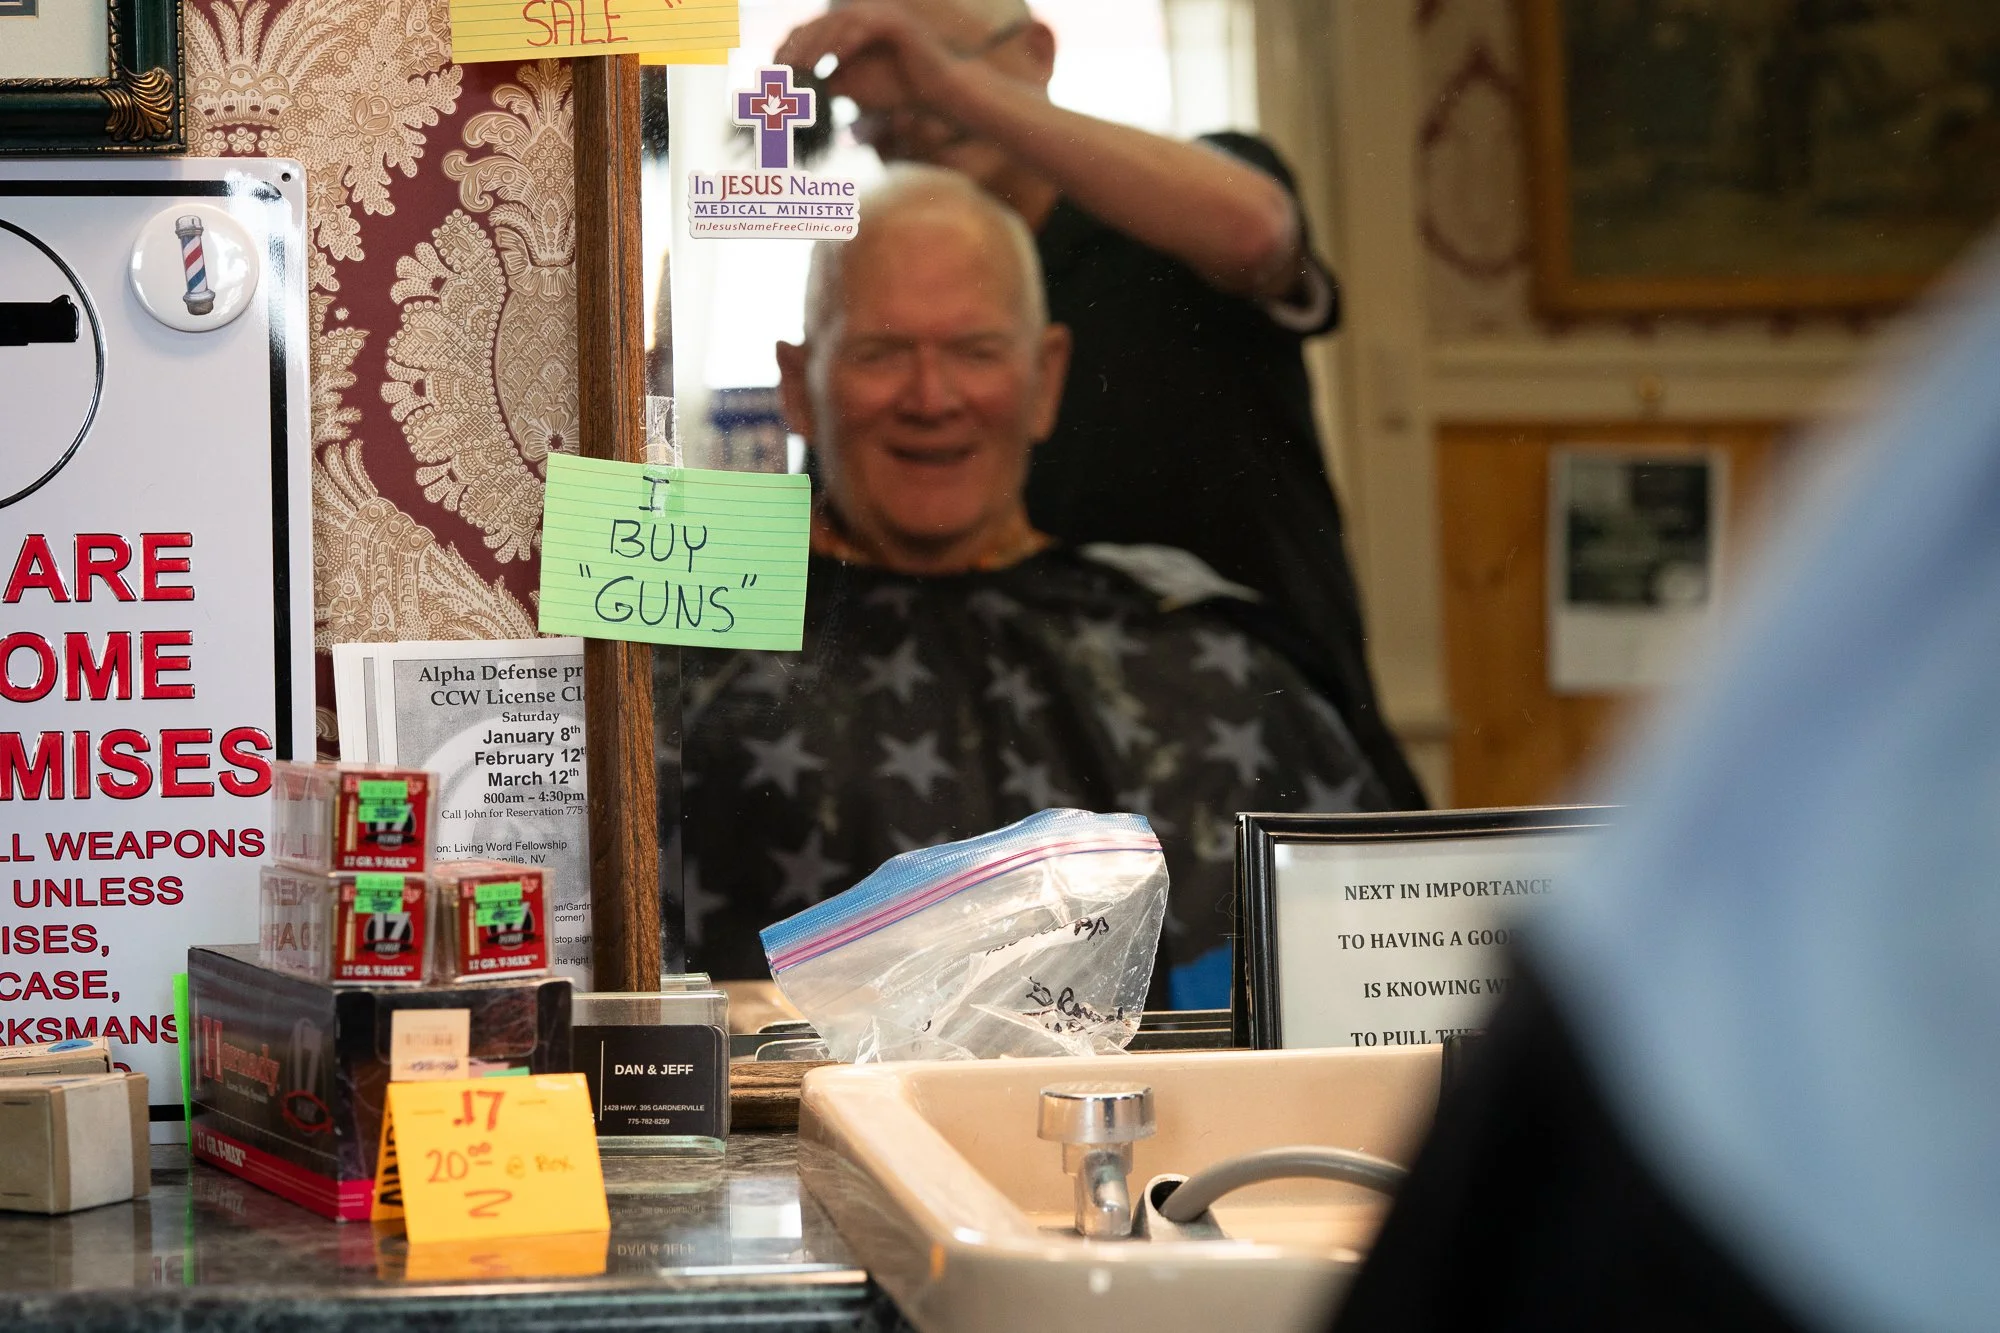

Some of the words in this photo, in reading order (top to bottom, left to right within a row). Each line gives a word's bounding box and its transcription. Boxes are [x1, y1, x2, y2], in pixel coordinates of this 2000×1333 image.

[522, 0, 628, 46] SALE
[694, 175, 714, 196] In
[720, 175, 783, 200] JESUS
[790, 176, 855, 197] Name
[695, 204, 767, 215] MEDICAL
[777, 204, 854, 216] MINISTRY
[694, 221, 854, 234] InJesusNameFreeClinic.org
[638, 475, 670, 512] I
[610, 519, 708, 573] BUY
[2, 532, 196, 604] ARE
[579, 562, 758, 634] "GUNS"
[418, 665, 476, 687] Alpha
[481, 664, 558, 681] Defense
[430, 689, 481, 706] CCW
[486, 688, 556, 705] License
[561, 686, 585, 702] Cl
[502, 710, 560, 724] Saturday
[482, 729, 555, 746] January
[560, 725, 581, 741] 8th
[475, 750, 555, 767] February
[488, 771, 543, 787] March
[549, 768, 579, 785] 12th
[483, 792, 525, 804] 800am
[538, 791, 585, 804] 4:30pm
[441, 809, 462, 819] Call
[464, 809, 487, 820] John
[489, 808, 504, 818] for
[506, 806, 564, 818] Reservation
[566, 806, 583, 816] 775
[46, 828, 266, 861] WEAPONS
[436, 844, 451, 853] on:
[454, 843, 484, 854] Living
[486, 841, 512, 852] Word
[515, 840, 568, 852] Fellowship
[530, 854, 546, 864] NV
[13, 875, 184, 908] UNLESS
[1344, 884, 1395, 901] NEXT
[1400, 883, 1420, 899] IN
[1426, 879, 1553, 898] IMPORTANCE
[555, 936, 573, 944] stop
[1338, 933, 1366, 950] TO
[1371, 930, 1445, 950] HAVING
[1450, 931, 1463, 946] A
[1467, 928, 1512, 946] GOO
[0, 970, 120, 1003] CASE,
[1364, 982, 1381, 998] IS
[1386, 978, 1481, 998] KNOWING
[1351, 1030, 1378, 1047] TO
[1382, 1029, 1432, 1046] PULL
[614, 1064, 644, 1075] DAN
[647, 1064, 657, 1075] &
[660, 1064, 694, 1075] JEFF
[653, 1104, 705, 1112] GARDNERVILLE
